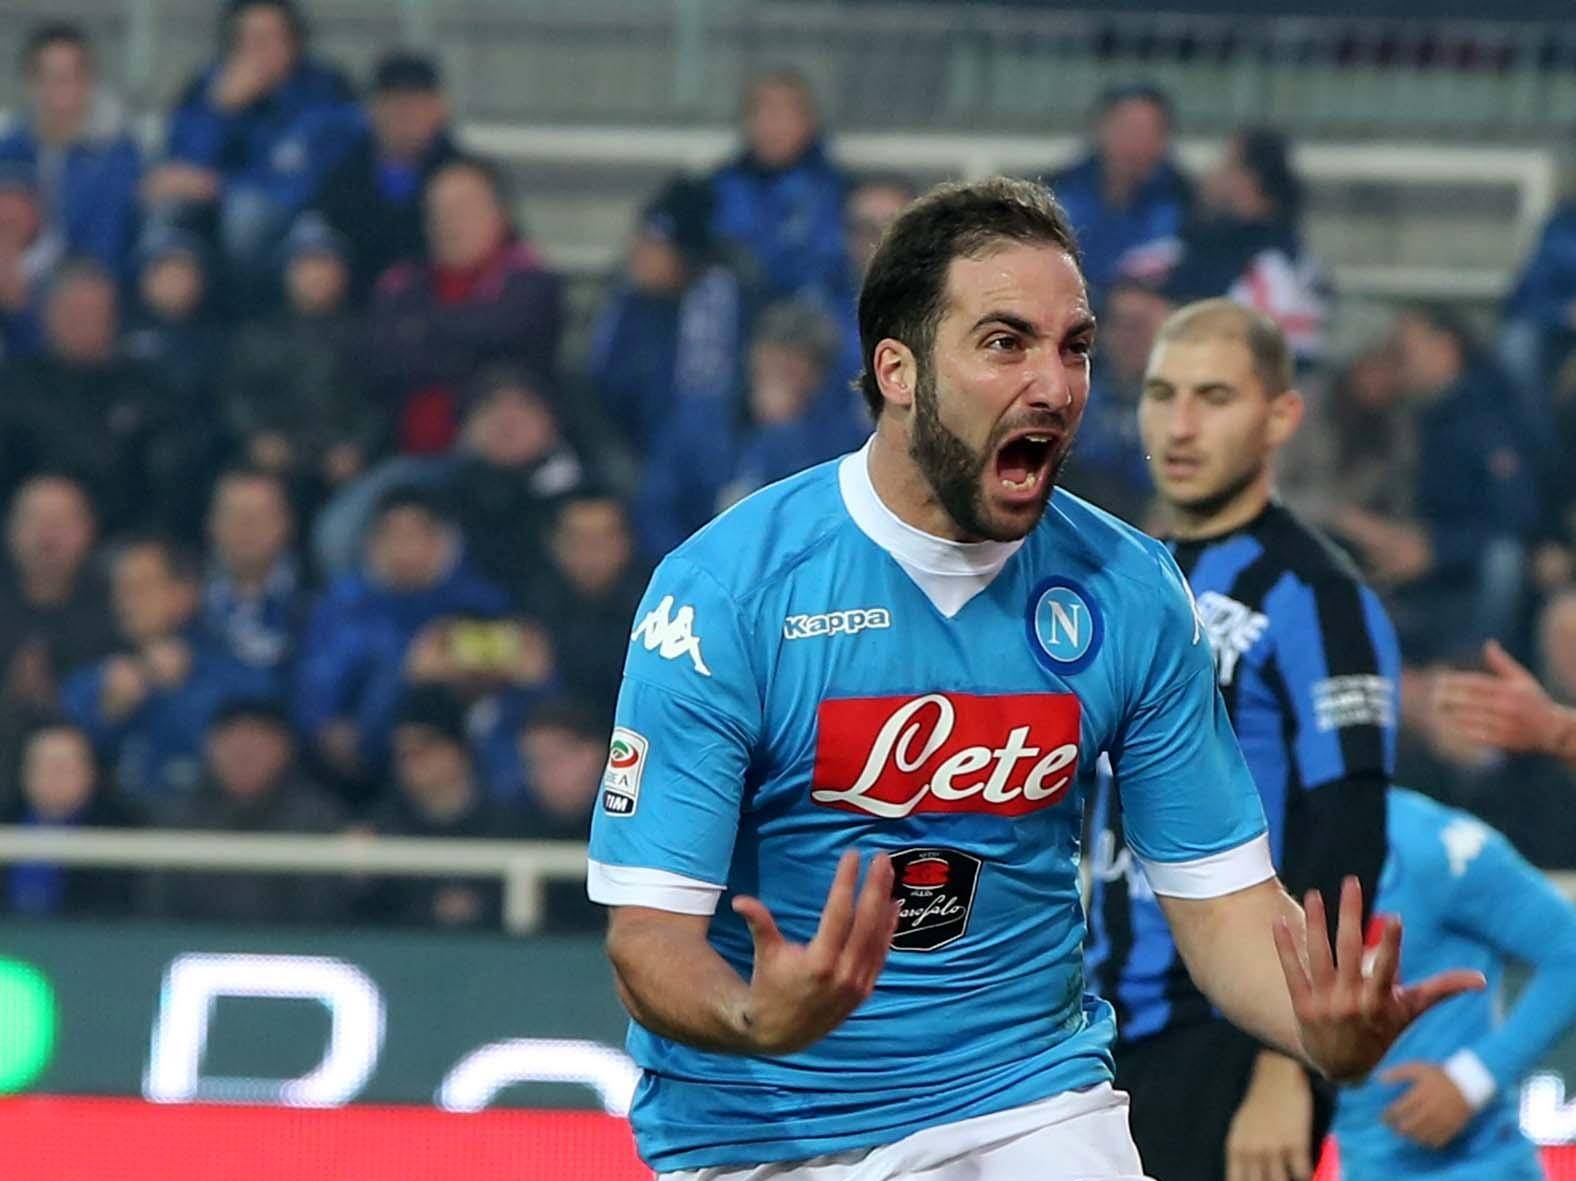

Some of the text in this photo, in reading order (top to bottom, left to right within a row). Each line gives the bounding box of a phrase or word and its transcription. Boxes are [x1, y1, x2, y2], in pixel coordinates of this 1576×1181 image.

[784, 608, 891, 640] Kappa
[1047, 600, 1080, 648] N
[811, 693, 1079, 818] Lete
